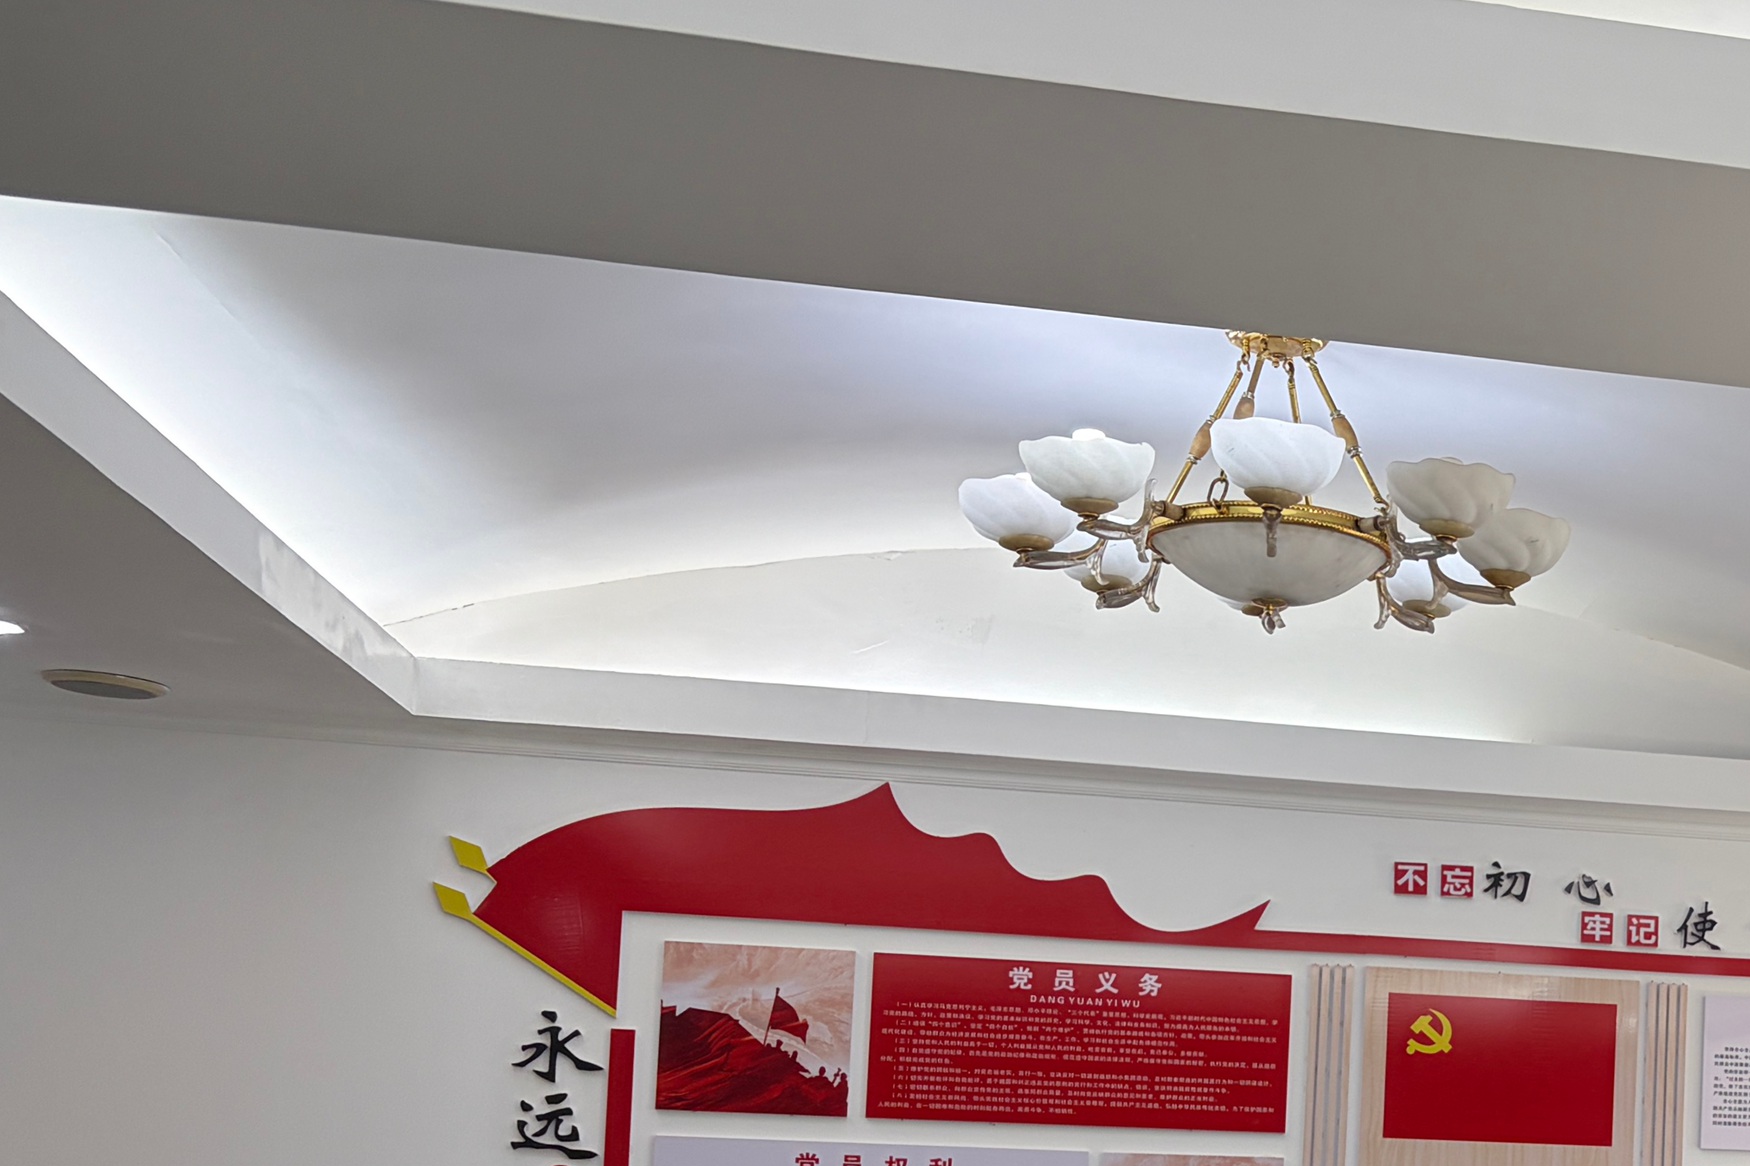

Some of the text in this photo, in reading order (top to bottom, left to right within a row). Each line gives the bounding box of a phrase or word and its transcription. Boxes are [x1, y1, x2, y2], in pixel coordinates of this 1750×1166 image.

[1394, 861, 1614, 906] 不忘初心
[1008, 966, 1162, 997] 党员义务
[1029, 994, 1141, 1009] DANG YUAN YI WU
